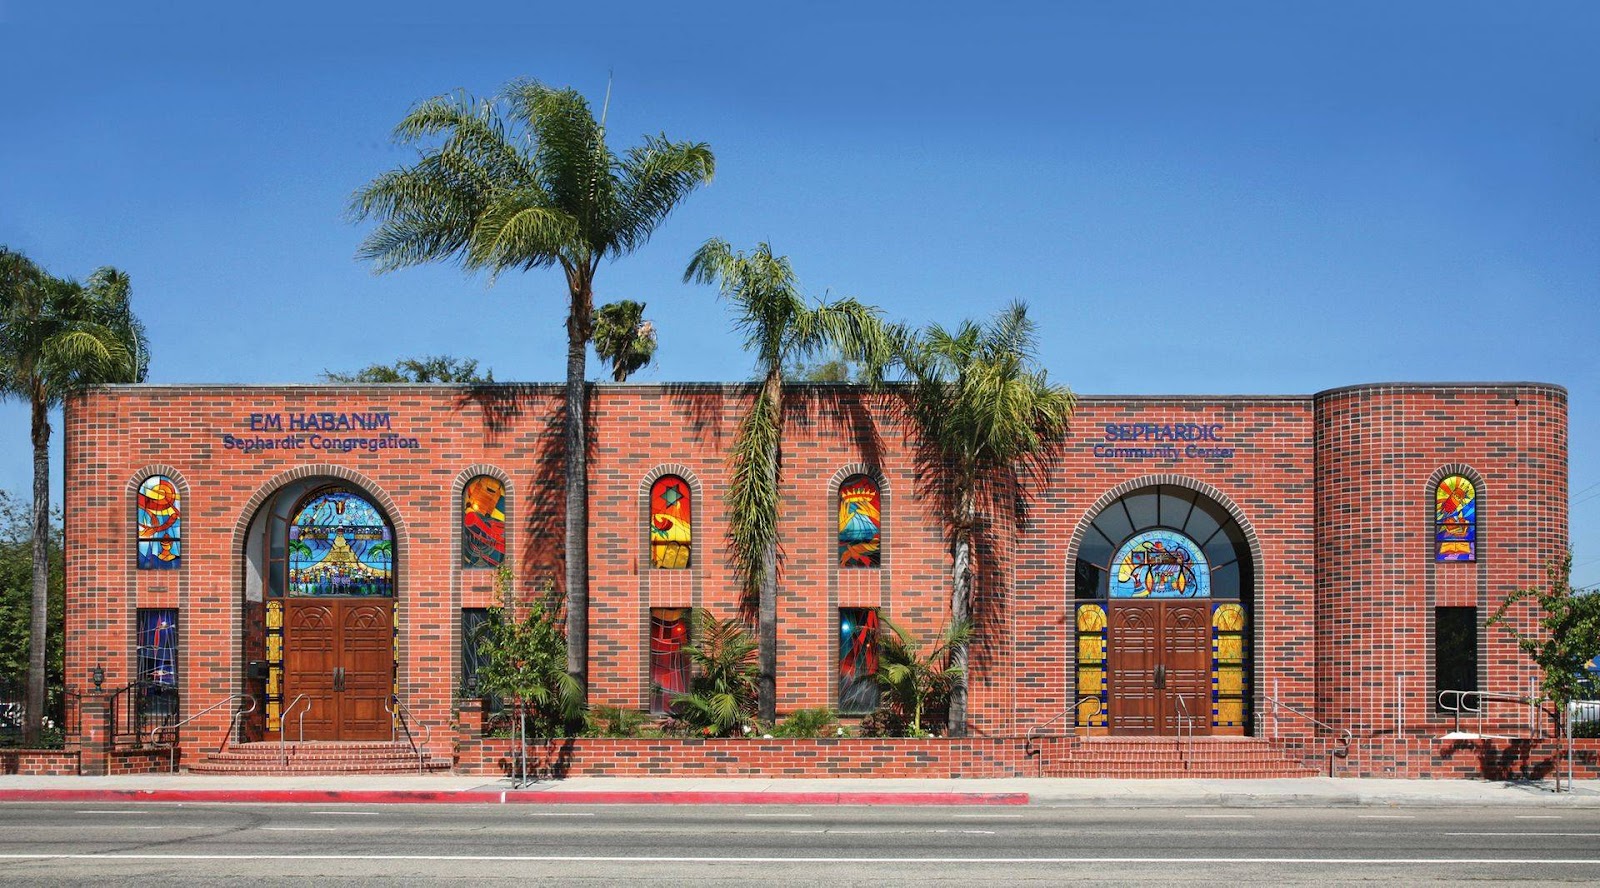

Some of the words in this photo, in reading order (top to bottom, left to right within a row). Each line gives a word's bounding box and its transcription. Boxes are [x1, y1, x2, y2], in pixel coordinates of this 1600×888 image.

[250, 413, 282, 431] EM
[289, 413, 391, 430] HABANIM
[1105, 423, 1223, 441] SEPHARDIC
[223, 434, 304, 453] Sephardic
[309, 434, 419, 452] Congregation
[1093, 444, 1180, 461] Community
[1184, 444, 1235, 458] Center
